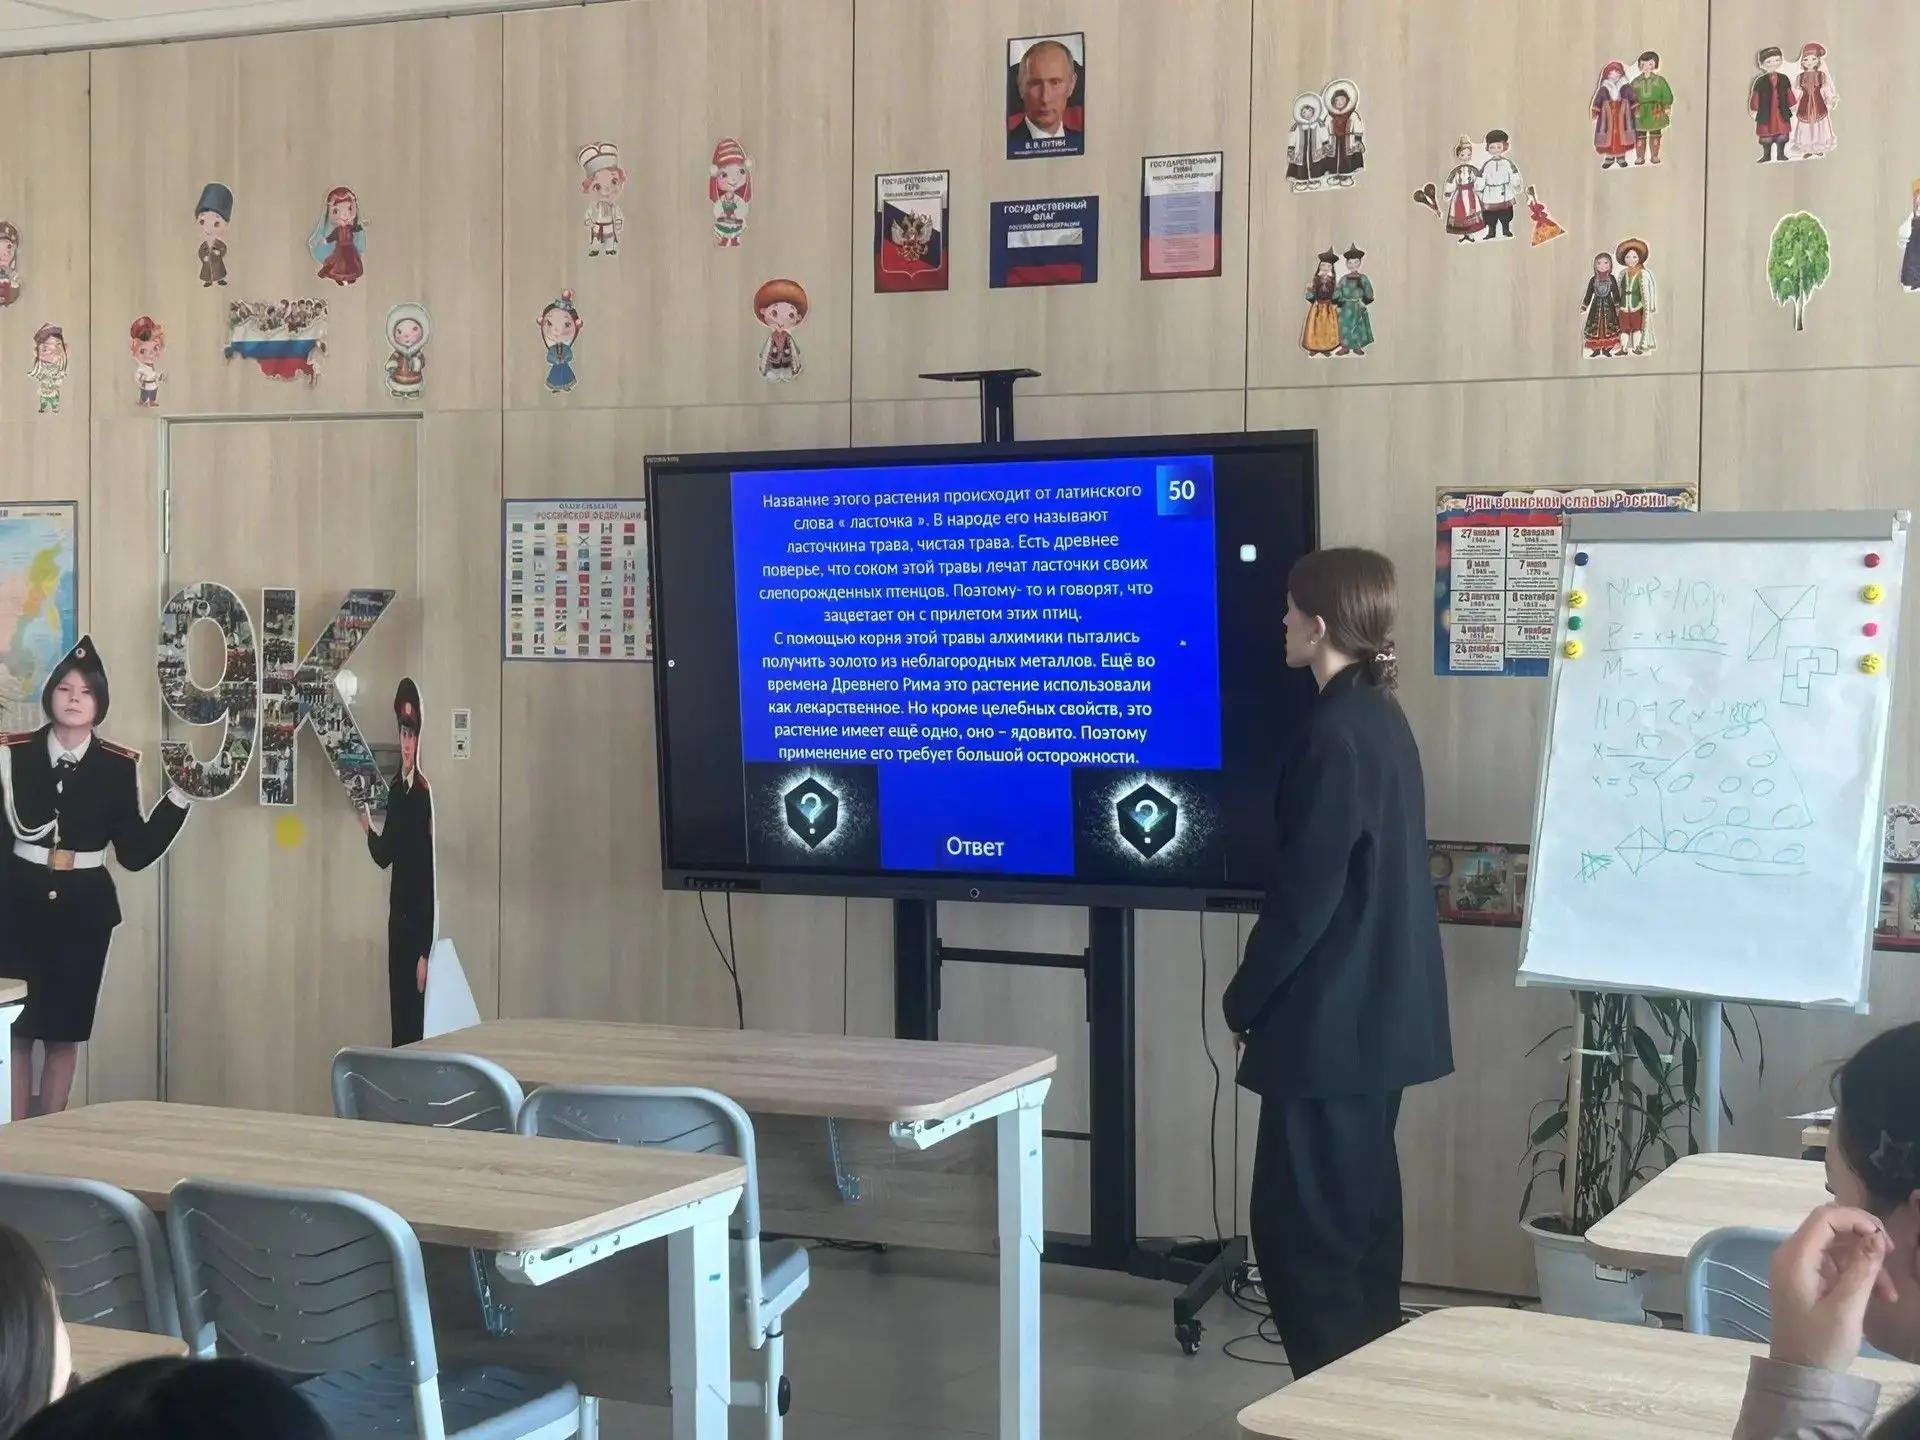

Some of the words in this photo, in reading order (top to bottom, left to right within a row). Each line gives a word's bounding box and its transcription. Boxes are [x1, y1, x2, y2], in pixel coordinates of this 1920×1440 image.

[1041, 139, 1066, 148] ПУТИН
[1150, 156, 1217, 168] ГОСУДАРСТВЕННЫЙ
[881, 175, 944, 185] ГОСУДАРСТВЕННЫЙ
[1003, 200, 1087, 214] ГОСУДАРСТВЕННЫЙ
[1032, 212, 1055, 221] ФЛАГ
[762, 494, 830, 509] Название
[832, 494, 871, 506] этого
[874, 491, 940, 508] растения
[943, 488, 1031, 506] происходит
[1034, 488, 1052, 500] от
[1054, 485, 1142, 500] латинского
[1168, 479, 1195, 501] 50
[1465, 494, 1493, 511] Дни
[1564, 495, 1610, 509] славы
[1613, 492, 1668, 508] России
[793, 518, 834, 531] слова
[849, 516, 913, 529] ласточка
[933, 512, 943, 527] В
[947, 513, 1002, 529] народе
[1004, 512, 1030, 525] его
[1033, 510, 1109, 524] называют
[1461, 528, 1472, 539] 27
[1513, 527, 1520, 538] 2
[786, 540, 866, 554] ласточкина
[869, 539, 914, 555] трава,
[916, 538, 965, 551] чистая
[968, 537, 1015, 553] трава.
[1018, 533, 1051, 549] Есть
[1053, 535, 1120, 552] древнее
[762, 564, 825, 580] поверье,
[827, 563, 851, 576] что
[853, 563, 899, 576] соком
[901, 559, 935, 575] этой
[937, 561, 982, 577] травы
[985, 560, 1028, 574] лечат
[1031, 559, 1100, 573] ласточки
[1103, 558, 1149, 571] своих
[1519, 560, 1526, 570] 7
[758, 587, 883, 603] слепорожденных
[885, 586, 950, 601] птенцов.
[1025, 585, 1043, 597] то
[1046, 584, 1056, 597] и
[1059, 583, 1124, 599] говорят,
[1127, 583, 1154, 595] что
[1458, 592, 1470, 602] 23
[823, 610, 895, 625] зацветает
[896, 609, 915, 622] он
[918, 609, 927, 622] с
[930, 608, 1003, 624] прилетом
[1006, 608, 1039, 620] этих
[1042, 607, 1082, 623] птиц.
[773, 631, 784, 646] С
[786, 633, 857, 648] помощью
[859, 633, 902, 648] корня
[904, 629, 938, 645] этой
[940, 632, 986, 647] травы
[989, 632, 1064, 645] алхимики
[1067, 631, 1141, 644] пытались
[1517, 625, 1523, 636] 7
[762, 656, 827, 672] получить
[828, 656, 878, 669] золото
[880, 656, 898, 669] из
[901, 652, 1017, 672] неблагородных
[1020, 655, 1097, 668] металлов.
[1100, 652, 1133, 672] Ещё
[1136, 655, 1156, 668] во
[767, 679, 828, 694] времена
[830, 676, 900, 695] Древнего
[902, 676, 941, 692] Рима
[943, 679, 968, 692] это
[971, 679, 1040, 695] растение
[1043, 679, 1151, 692] использовали
[768, 702, 793, 715] как
[793, 702, 905, 718] лекарственное.
[907, 700, 929, 715] Но
[931, 703, 979, 719] кроме
[981, 699, 1057, 719] целебных
[1058, 700, 1123, 719] свойств,
[1126, 704, 1153, 716] это
[774, 725, 839, 740] растение
[841, 725, 886, 738] имеет
[887, 723, 919, 741] ещё
[920, 726, 963, 741] одно,
[966, 727, 995, 739] оно
[1010, 727, 1077, 742] ядовито.
[1080, 724, 1148, 744] Поэтому
[778, 747, 868, 762] применение
[870, 748, 894, 761] его
[896, 745, 954, 764] требует
[956, 745, 1024, 762] большой
[1026, 750, 1140, 767] осторожности.
[946, 835, 1005, 857] Ответ
